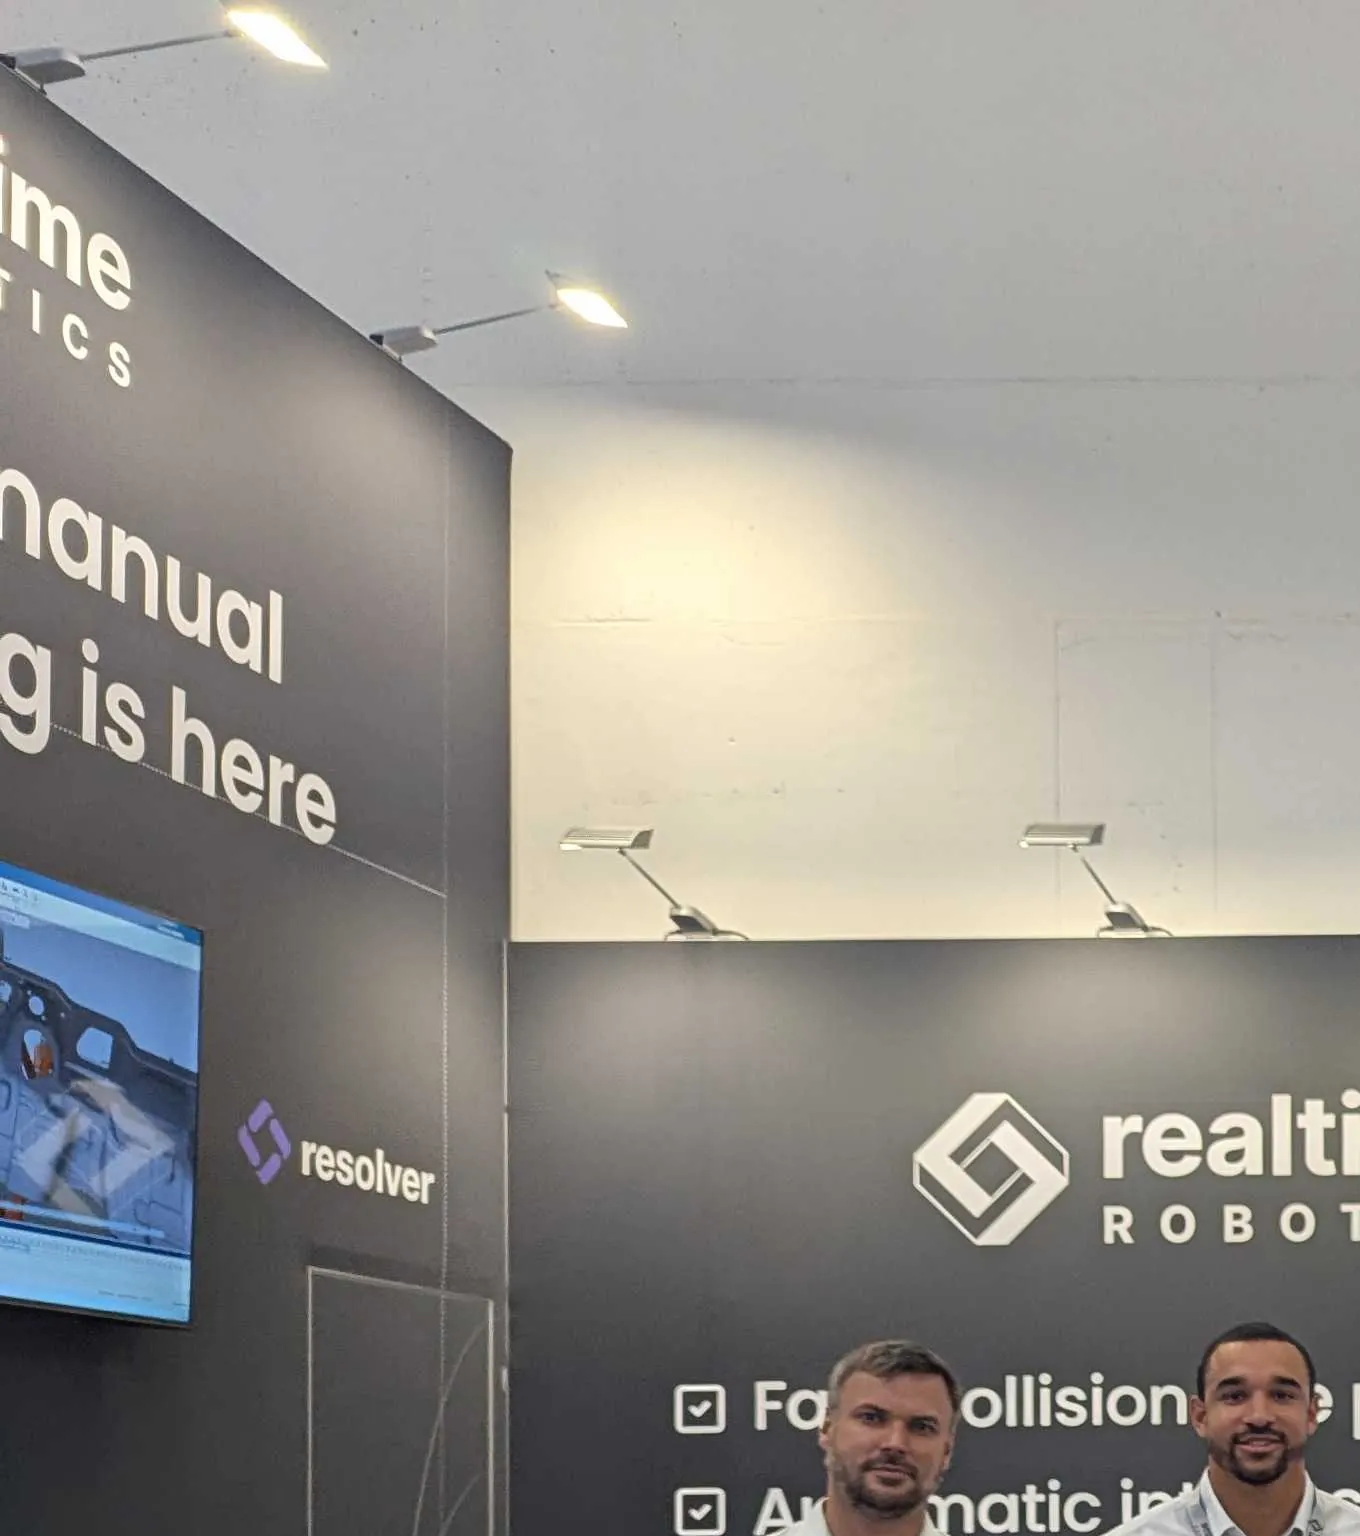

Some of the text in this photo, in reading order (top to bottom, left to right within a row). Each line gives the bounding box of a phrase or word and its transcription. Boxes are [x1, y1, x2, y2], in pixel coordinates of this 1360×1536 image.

[81, 638, 146, 763] is
[172, 685, 337, 845] here
[301, 1140, 436, 1205] resolver
[754, 1380, 829, 1431] Fa
